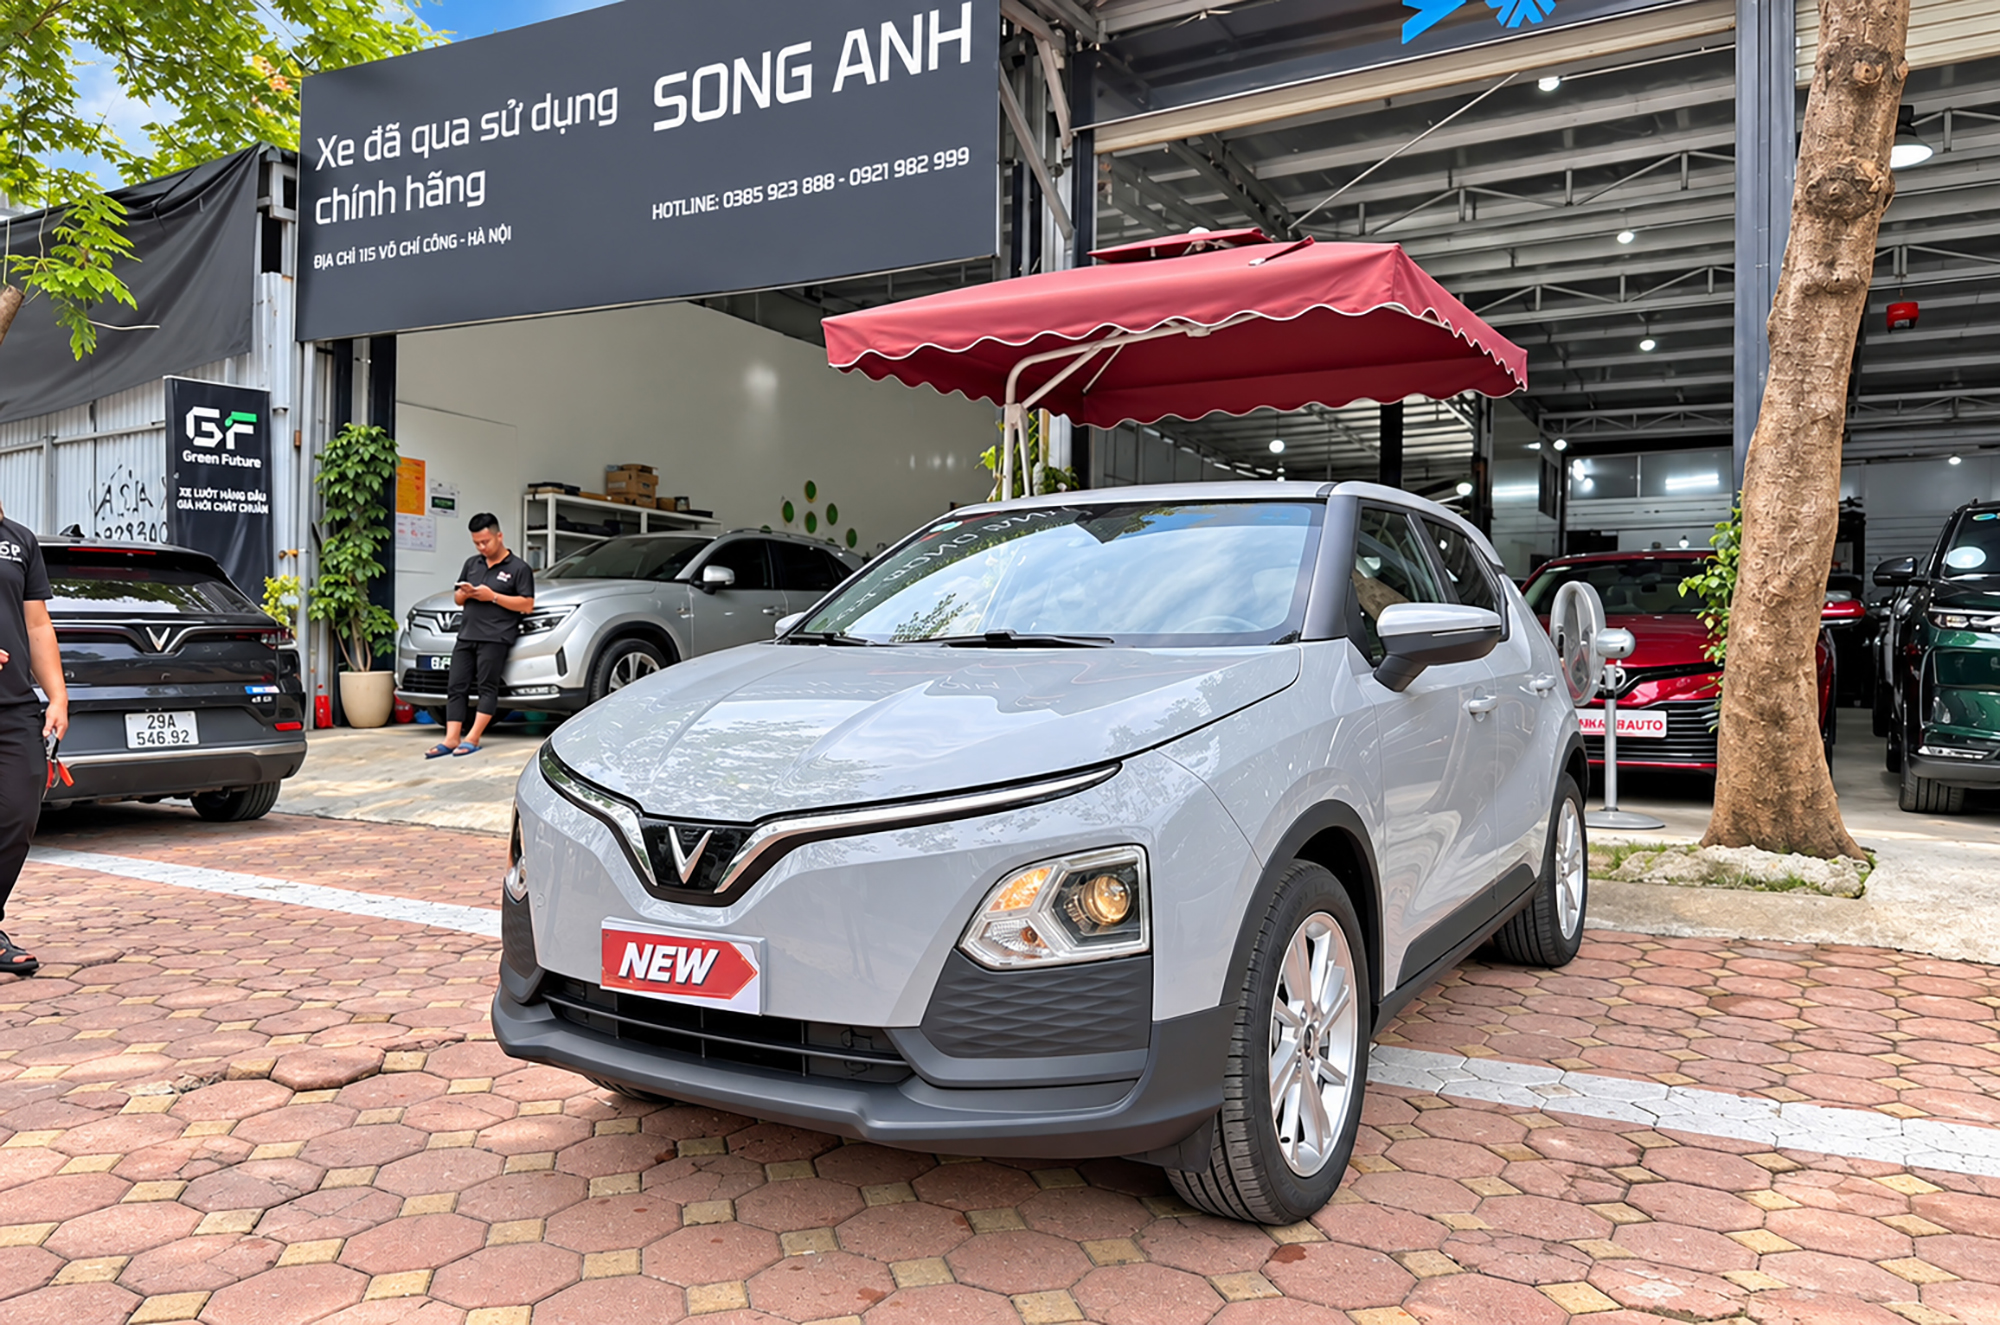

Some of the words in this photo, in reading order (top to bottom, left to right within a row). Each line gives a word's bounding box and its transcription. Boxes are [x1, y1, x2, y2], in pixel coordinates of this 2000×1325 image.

[654, 41, 812, 131] SONG
[832, 2, 971, 92] ANH
[316, 135, 354, 170] Xe
[364, 122, 400, 161] đã
[412, 118, 469, 158] qua
[481, 99, 523, 141] sử
[532, 88, 617, 134] dụng
[316, 180, 396, 224] chính
[406, 170, 485, 210] hãng
[653, 194, 719, 219] HOTLINE:
[723, 186, 763, 208] 0385
[768, 180, 797, 200] 923
[803, 173, 834, 194] 888
[850, 163, 888, 185] 0921
[894, 155, 928, 177] 982
[934, 147, 969, 170] 999
[314, 253, 333, 270] ĐỊA
[359, 247, 376, 262] 115
[379, 241, 396, 259] VÕ
[400, 236, 420, 256] CHÍ
[423, 233, 457, 252] CÔNG
[468, 227, 485, 246] HÀ
[489, 224, 511, 244] NỘI
[186, 406, 257, 450] GF
[182, 449, 219, 465] Green
[221, 453, 262, 468] Future
[136, 730, 189, 746] 546.92
[147, 714, 176, 730] 29A
[618, 942, 720, 986] NEW
